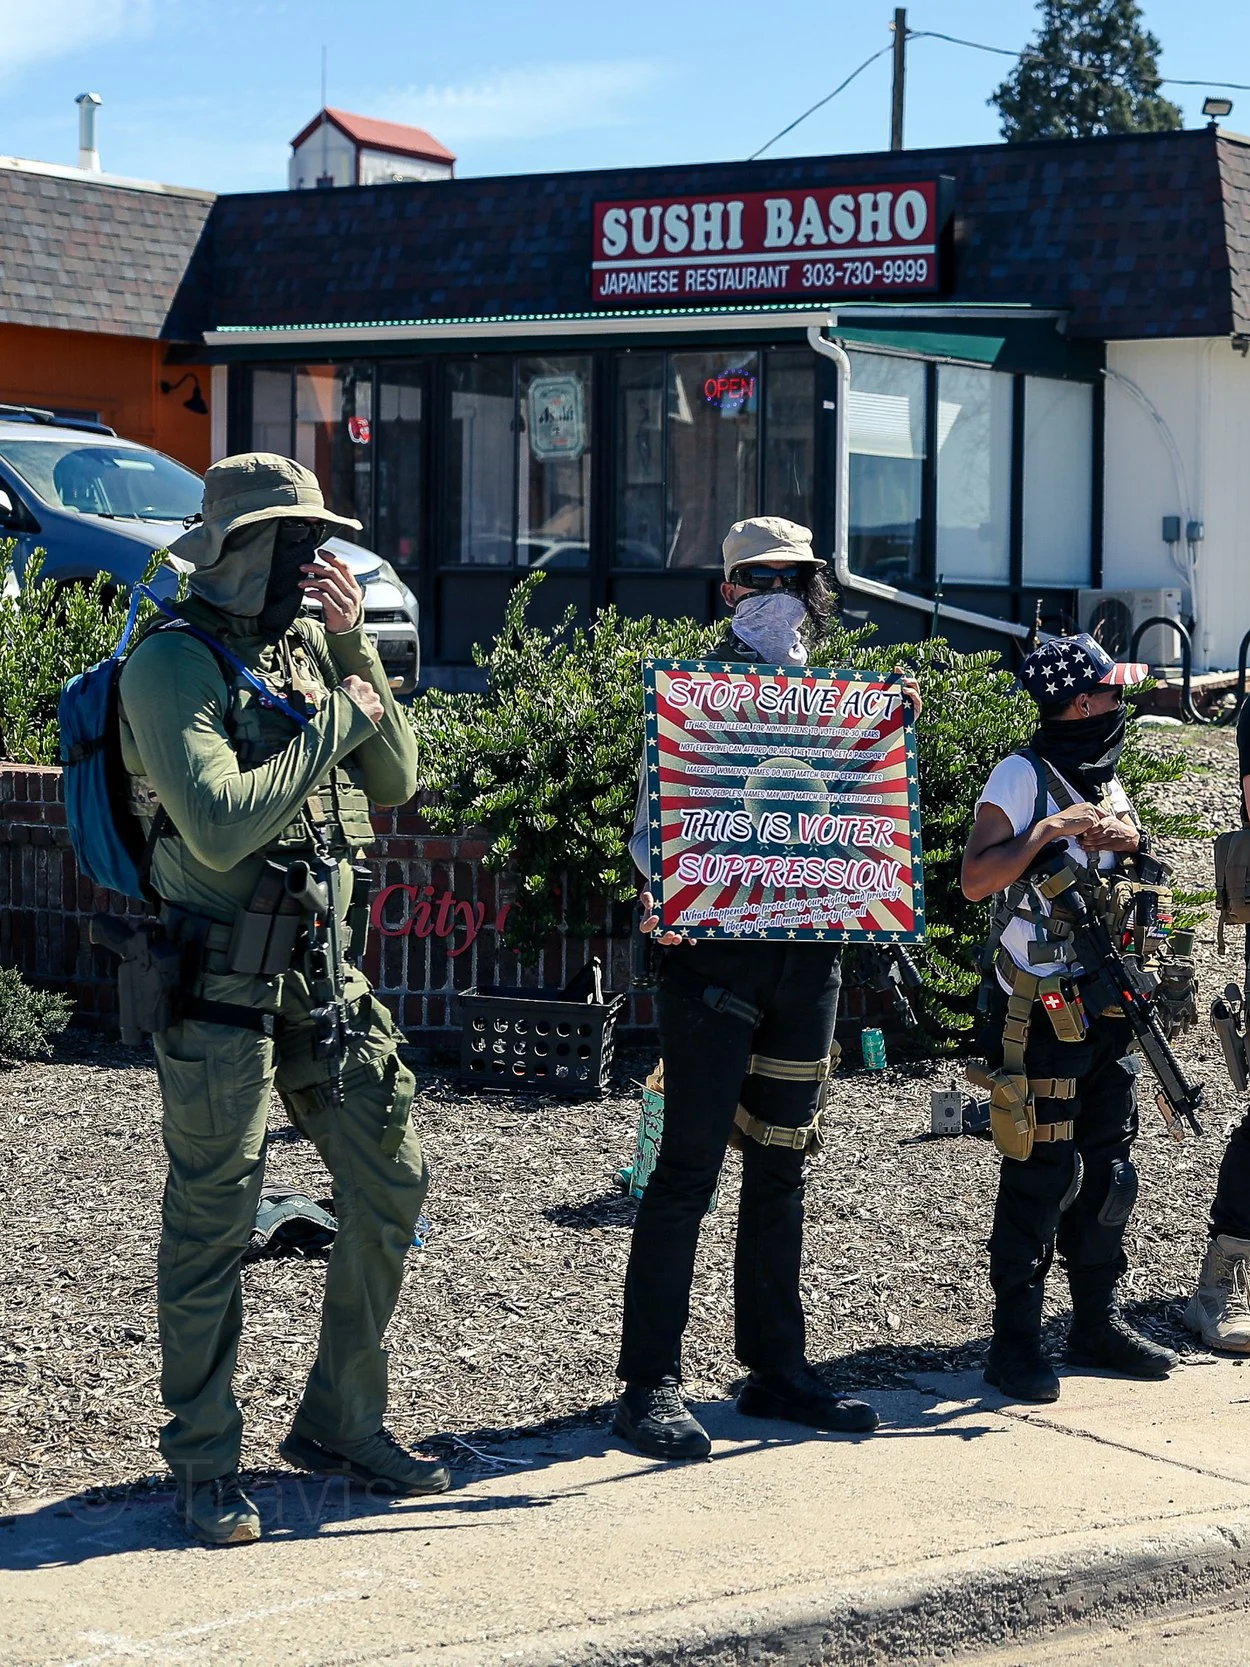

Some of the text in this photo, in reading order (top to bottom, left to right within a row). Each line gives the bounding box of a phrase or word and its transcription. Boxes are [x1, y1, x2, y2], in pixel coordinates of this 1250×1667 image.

[602, 190, 928, 256] SUSHI BASHO
[600, 258, 927, 296] JAPANESE RESTAURANT 303-730-9999
[704, 377, 755, 399] OPEN
[667, 679, 900, 720] STOP SAVE ACT
[685, 721, 692, 730] IT
[694, 722, 707, 730] HAS
[709, 722, 725, 730] BEEN
[726, 722, 751, 732] ILLEGAL
[753, 724, 766, 732] FOR
[810, 727, 819, 735] TO
[820, 728, 836, 736] VOTE
[850, 729, 860, 737] 30
[861, 730, 880, 739] YEARS
[680, 744, 694, 752] NOT
[696, 744, 727, 753] EVERYONE
[728, 745, 742, 753] CAN
[743, 746, 767, 755] AFFORD
[768, 747, 778, 755] OR
[779, 747, 793, 756] HAS
[794, 748, 806, 757] THE
[807, 749, 822, 757] TIME
[824, 750, 833, 758] TO
[834, 751, 847, 759] GET
[853, 752, 886, 761] PASSPORT
[686, 765, 883, 782] MARRIED WOMEN'S NAMES DO NOT MATCH BIRTH CERTIFICATES
[690, 787, 883, 804] TRANS PEOPLE'S NAMES MAY NOT MATCH BIRTH CERTIFICATES
[681, 809, 894, 848] THIS IS VOTER
[677, 853, 901, 891] SUPPRESSION
[370, 884, 485, 957] City
[681, 886, 901, 922] What happened to protecting our rights and privacy?
[724, 905, 867, 934] liberty for all means liberty for all
